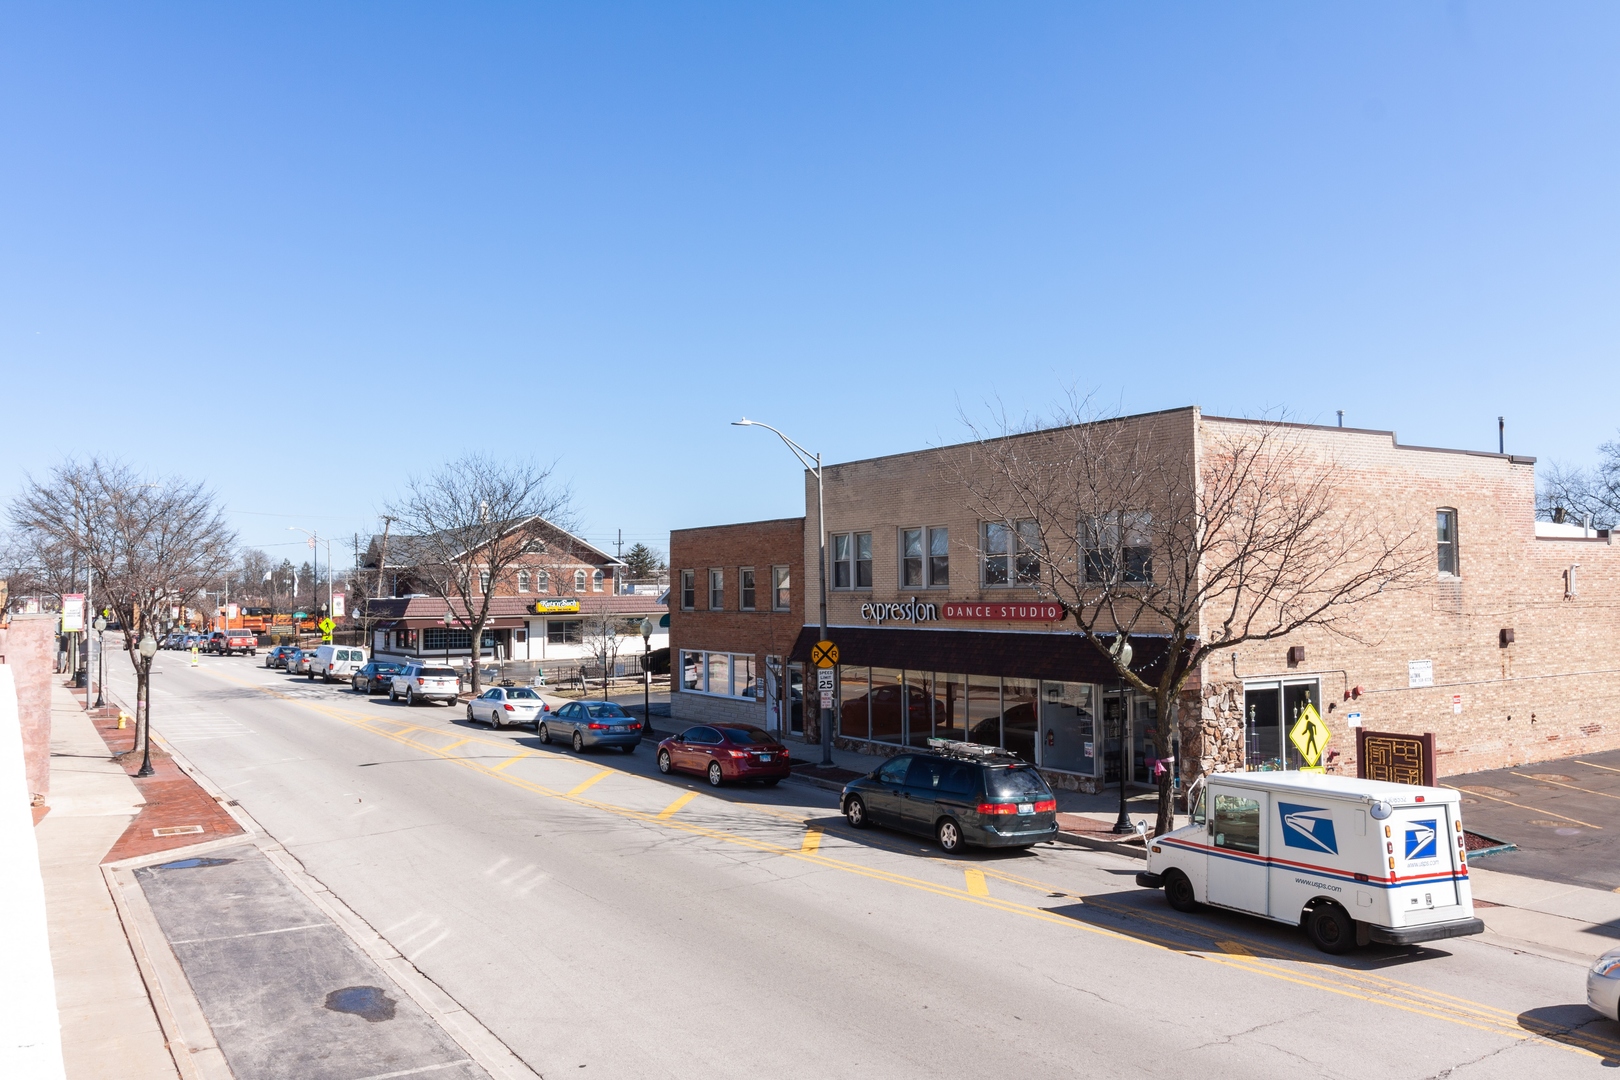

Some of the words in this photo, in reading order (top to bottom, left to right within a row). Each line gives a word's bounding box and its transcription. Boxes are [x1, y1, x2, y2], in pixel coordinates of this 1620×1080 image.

[861, 596, 938, 625] expression
[947, 606, 991, 617] DANCE
[1001, 606, 1056, 618] STUDIO
[819, 680, 833, 689] 25
[1406, 859, 1440, 869] www.usps.com
[1294, 876, 1342, 893] www.usps.com
